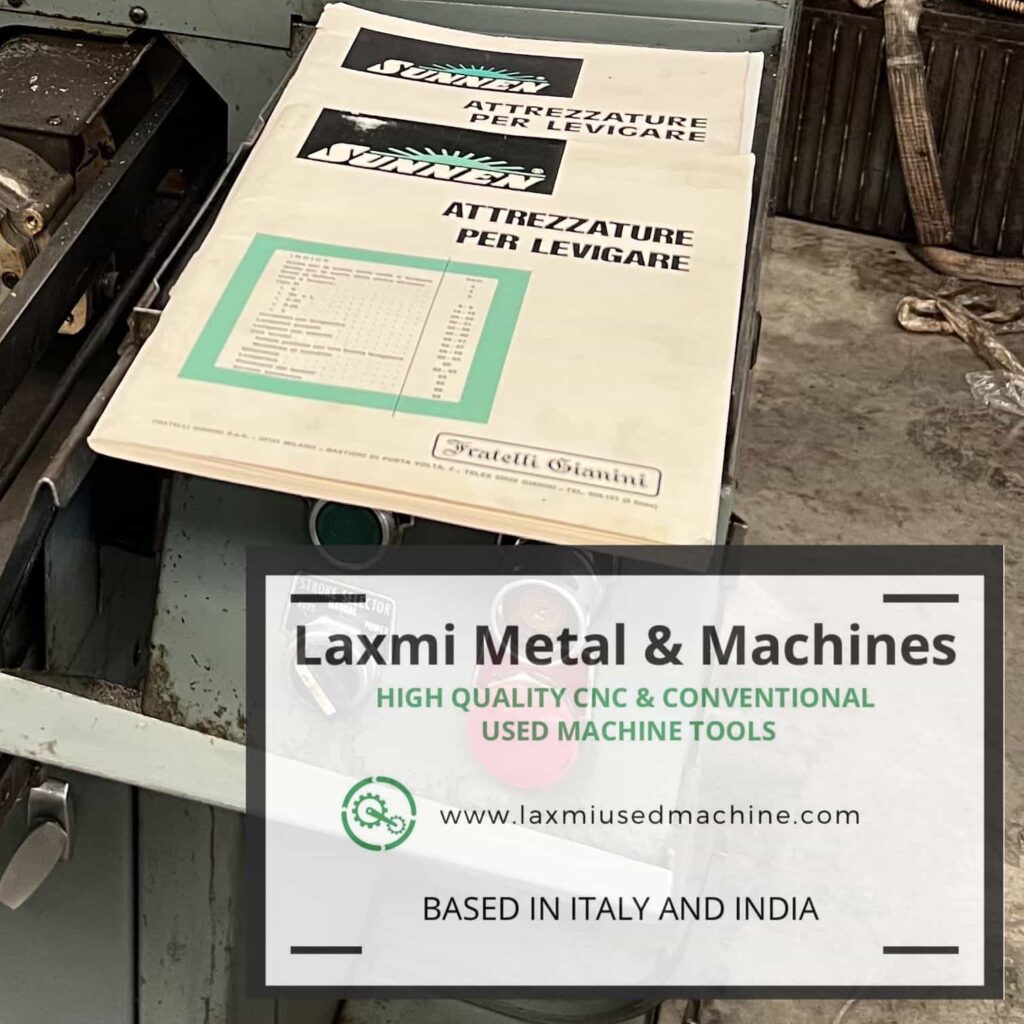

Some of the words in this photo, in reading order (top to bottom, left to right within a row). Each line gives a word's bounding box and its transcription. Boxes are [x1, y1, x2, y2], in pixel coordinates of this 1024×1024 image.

[366, 58, 550, 94] SUNNEN
[464, 100, 708, 129] ATTREZZATURE
[469, 113, 529, 129] PER
[547, 120, 707, 143] LEVIGARE
[307, 142, 546, 192] SUNNEN
[442, 201, 695, 247] ATTREZZATURE
[456, 228, 519, 251] PER
[531, 236, 690, 273] LEVIGARE
